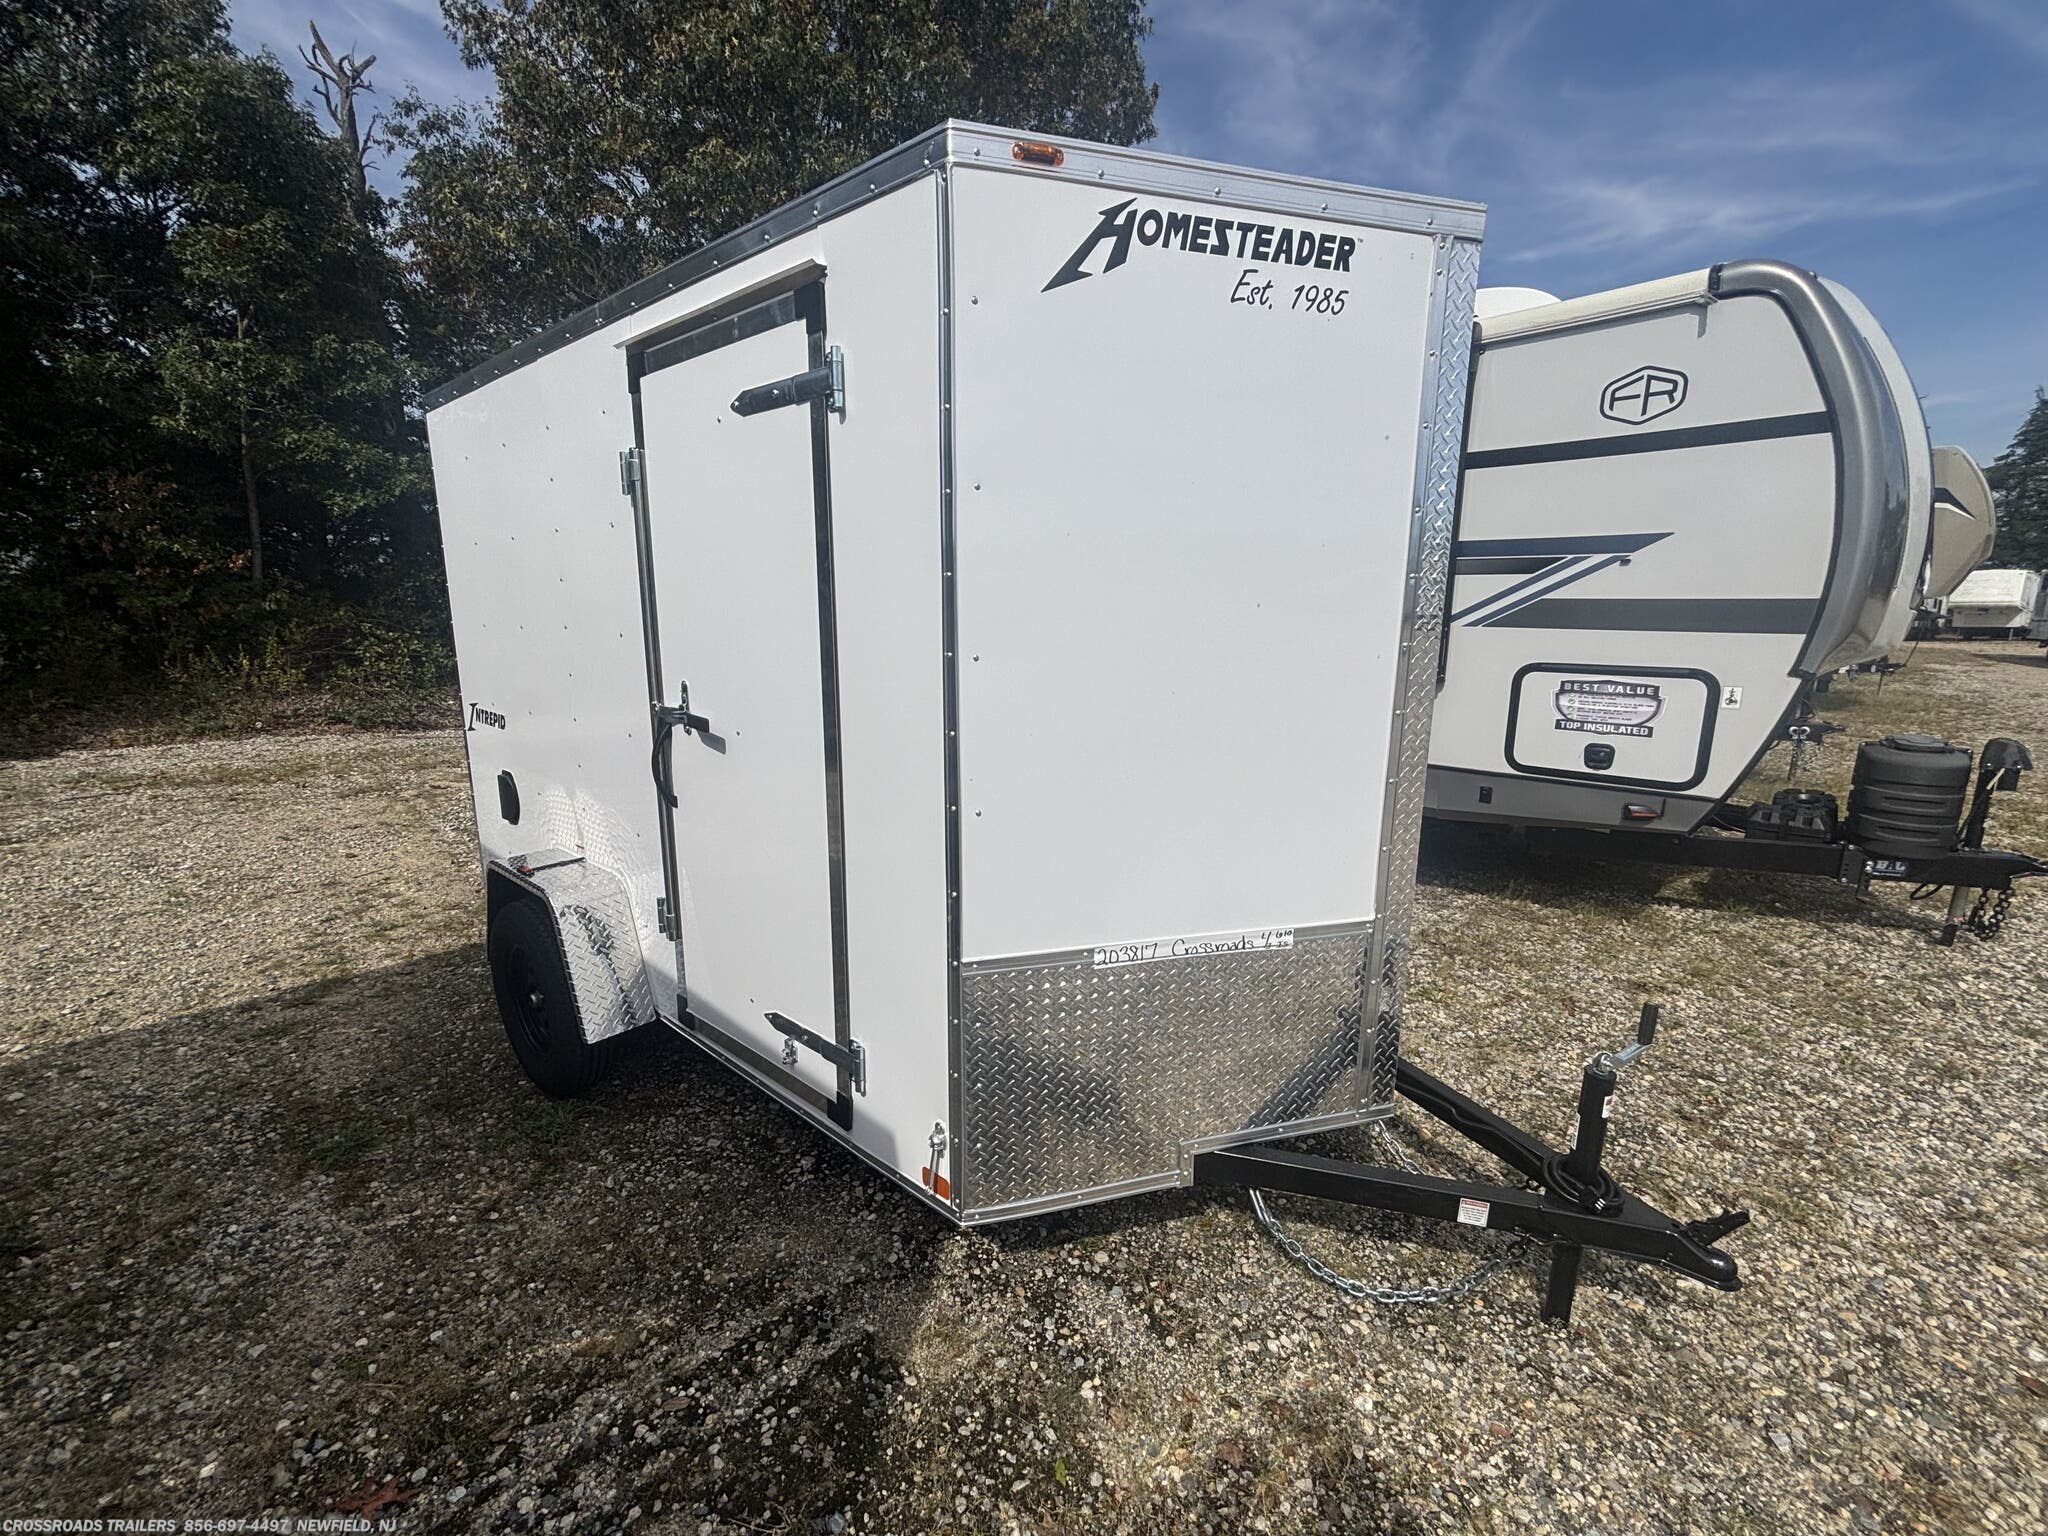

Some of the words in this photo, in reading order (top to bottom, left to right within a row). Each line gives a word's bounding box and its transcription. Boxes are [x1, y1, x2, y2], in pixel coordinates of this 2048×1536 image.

[1040, 197, 1356, 293] HOMESTEADER
[1230, 268, 1273, 310] Est.
[1291, 285, 1349, 316] 1985
[1609, 374, 1679, 417] FR
[1564, 682, 1600, 692] BEST
[1606, 685, 1656, 696] VALUE
[467, 702, 506, 732] INTREPID
[1559, 720, 1581, 729] TOP
[1583, 722, 1649, 736] INSULATED
